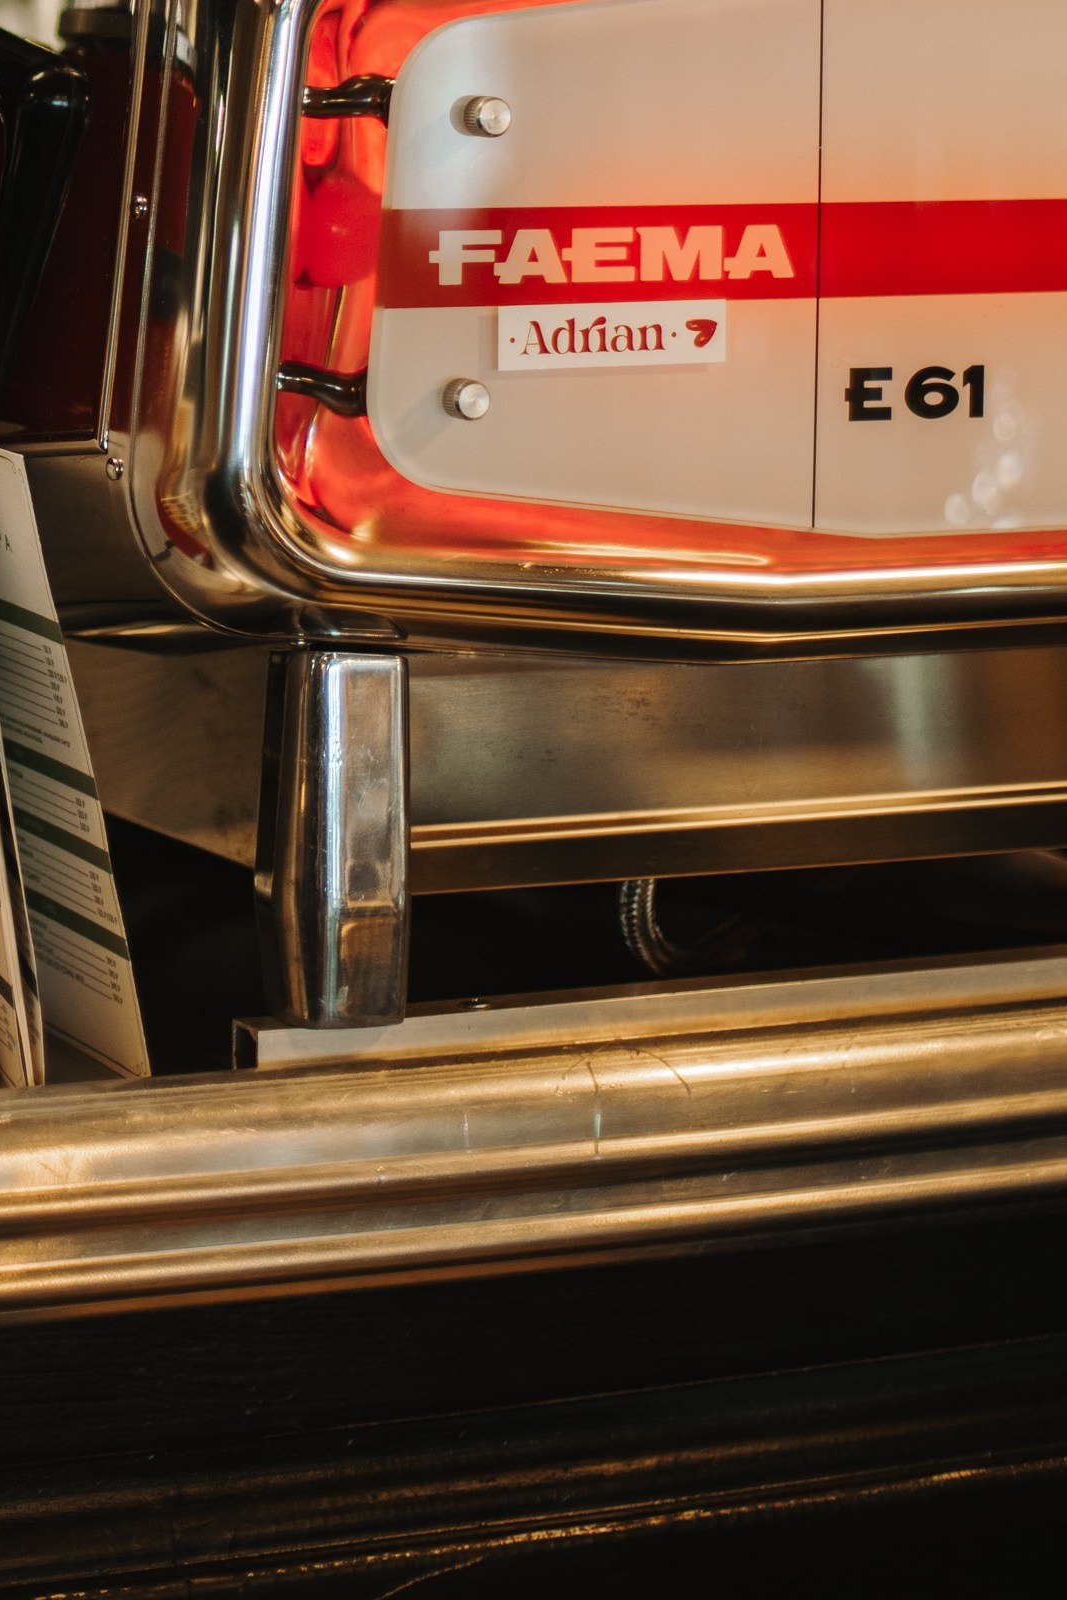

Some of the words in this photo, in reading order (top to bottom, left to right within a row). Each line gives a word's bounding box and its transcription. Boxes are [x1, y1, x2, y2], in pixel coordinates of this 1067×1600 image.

[429, 223, 795, 287] FAEMA
[844, 366, 893, 421] E
[904, 364, 986, 419] 61
